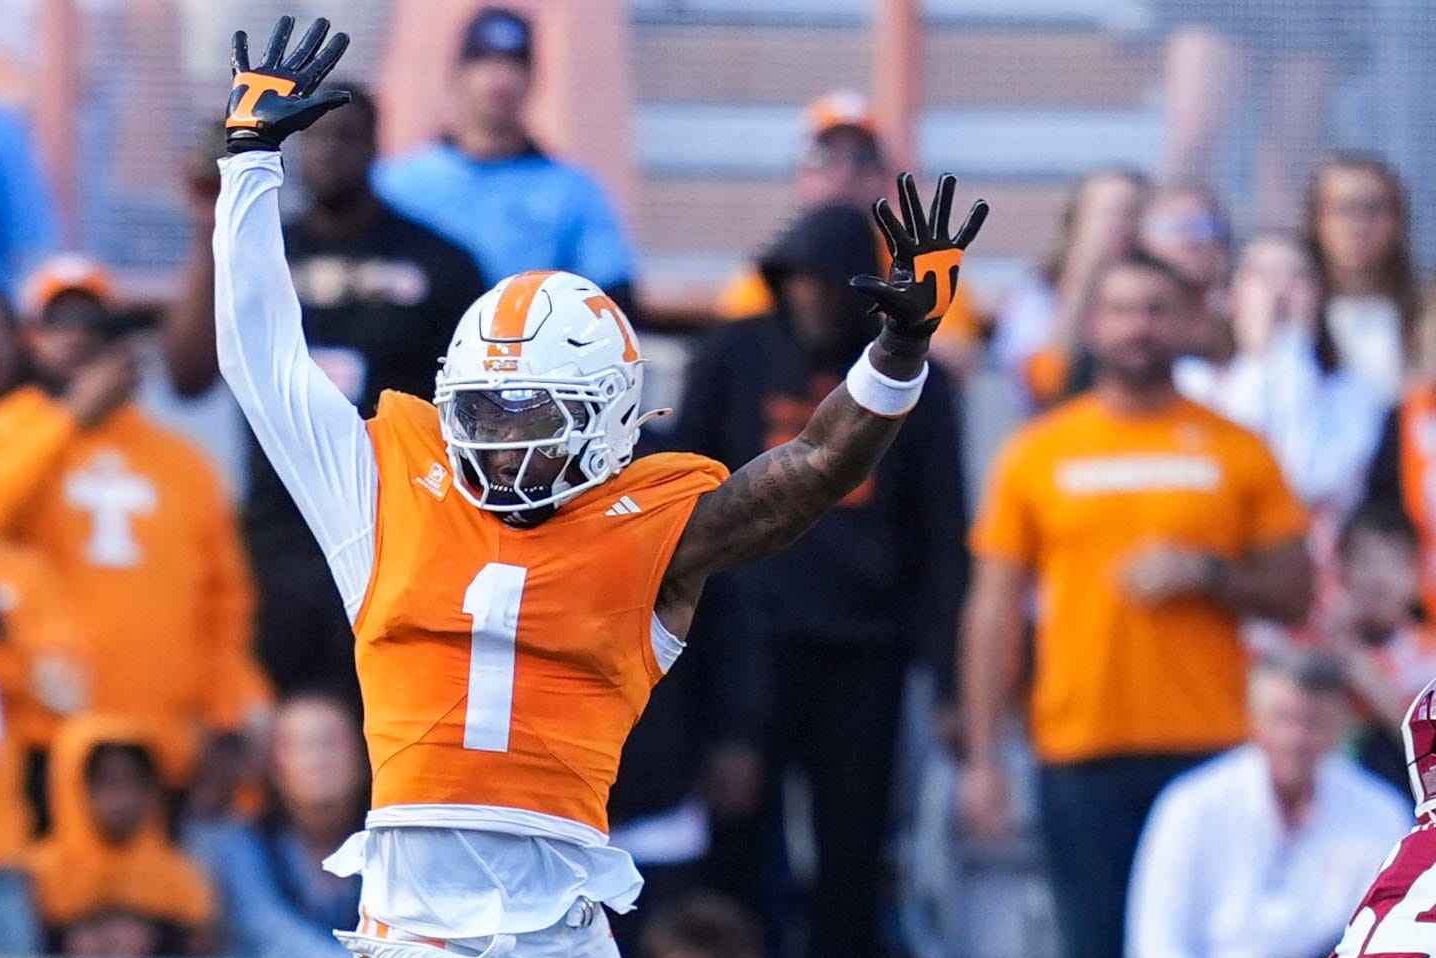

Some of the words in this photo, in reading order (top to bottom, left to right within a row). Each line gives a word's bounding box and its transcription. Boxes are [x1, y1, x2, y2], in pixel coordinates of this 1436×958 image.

[226, 71, 297, 128] T
[913, 248, 964, 319] T
[463, 562, 527, 752] 1
